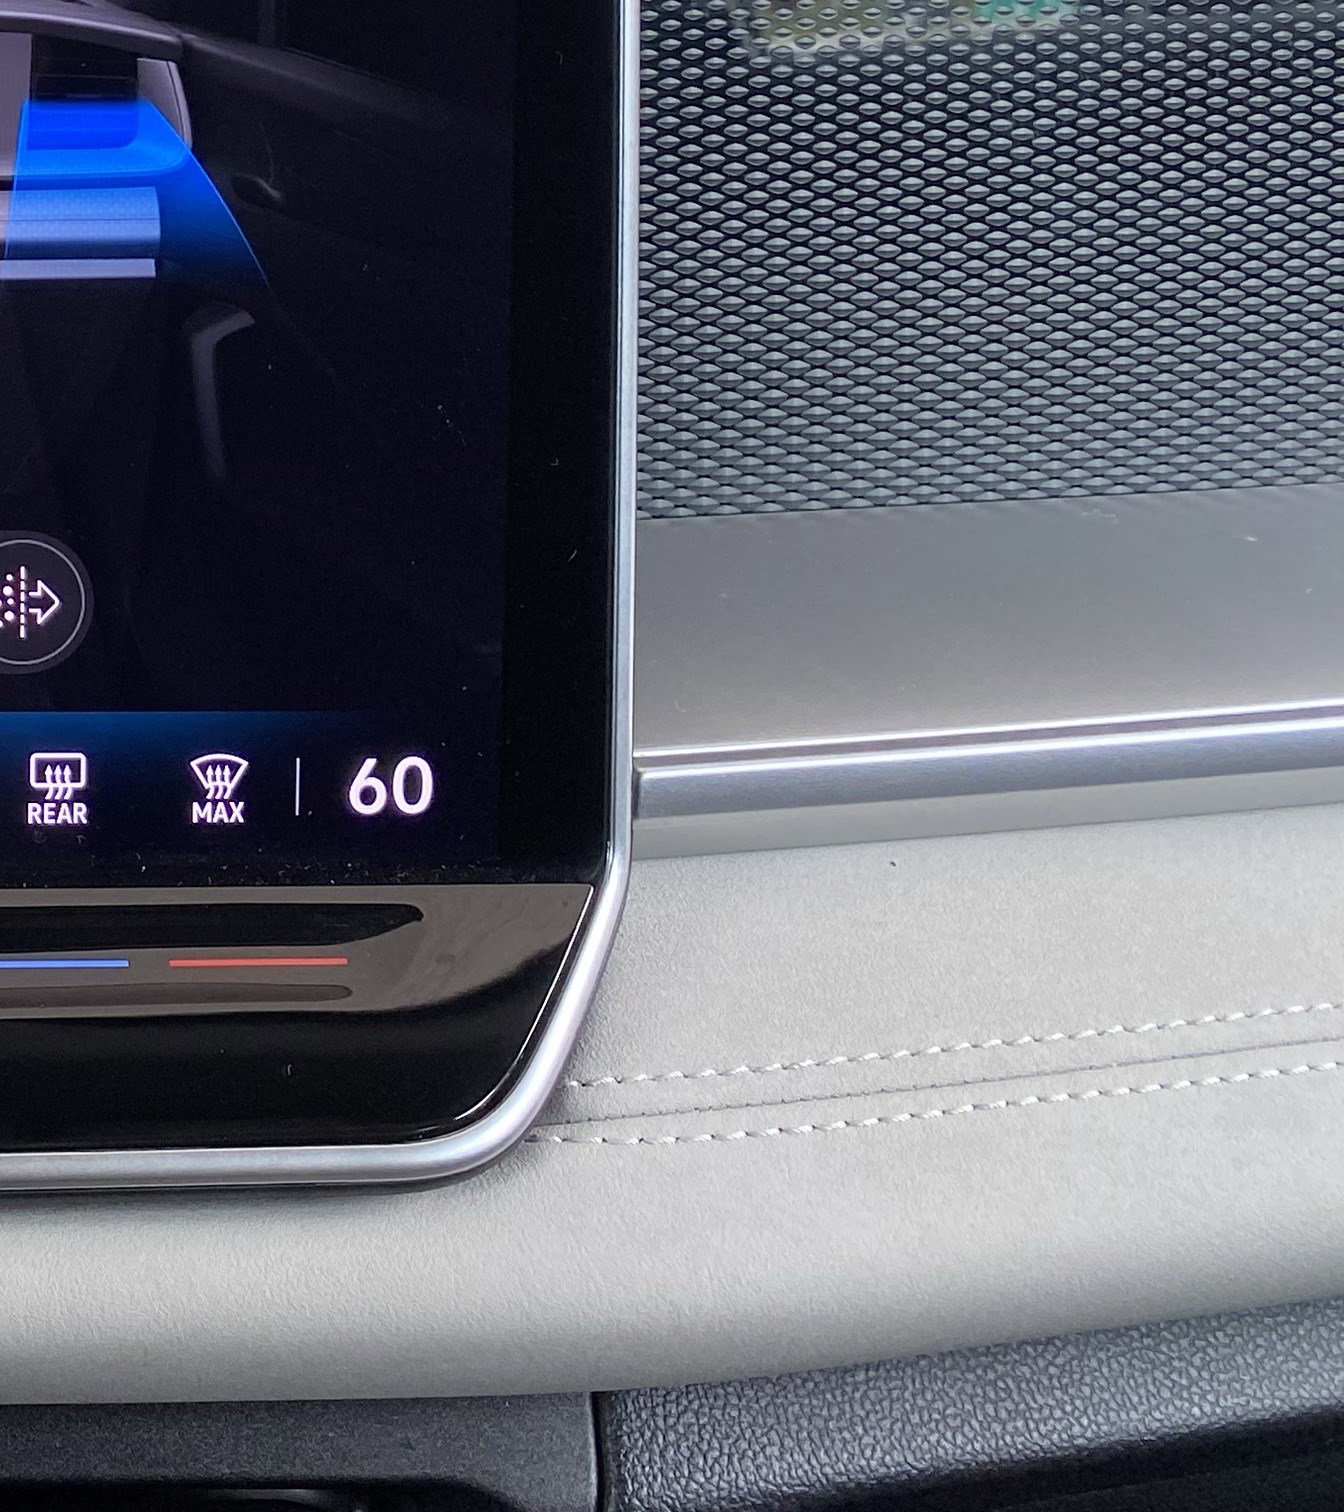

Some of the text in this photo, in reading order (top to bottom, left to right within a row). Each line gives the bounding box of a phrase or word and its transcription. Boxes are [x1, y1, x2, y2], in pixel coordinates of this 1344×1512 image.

[348, 755, 435, 817] 60
[27, 800, 88, 826] REAR
[191, 800, 246, 825] MAX
